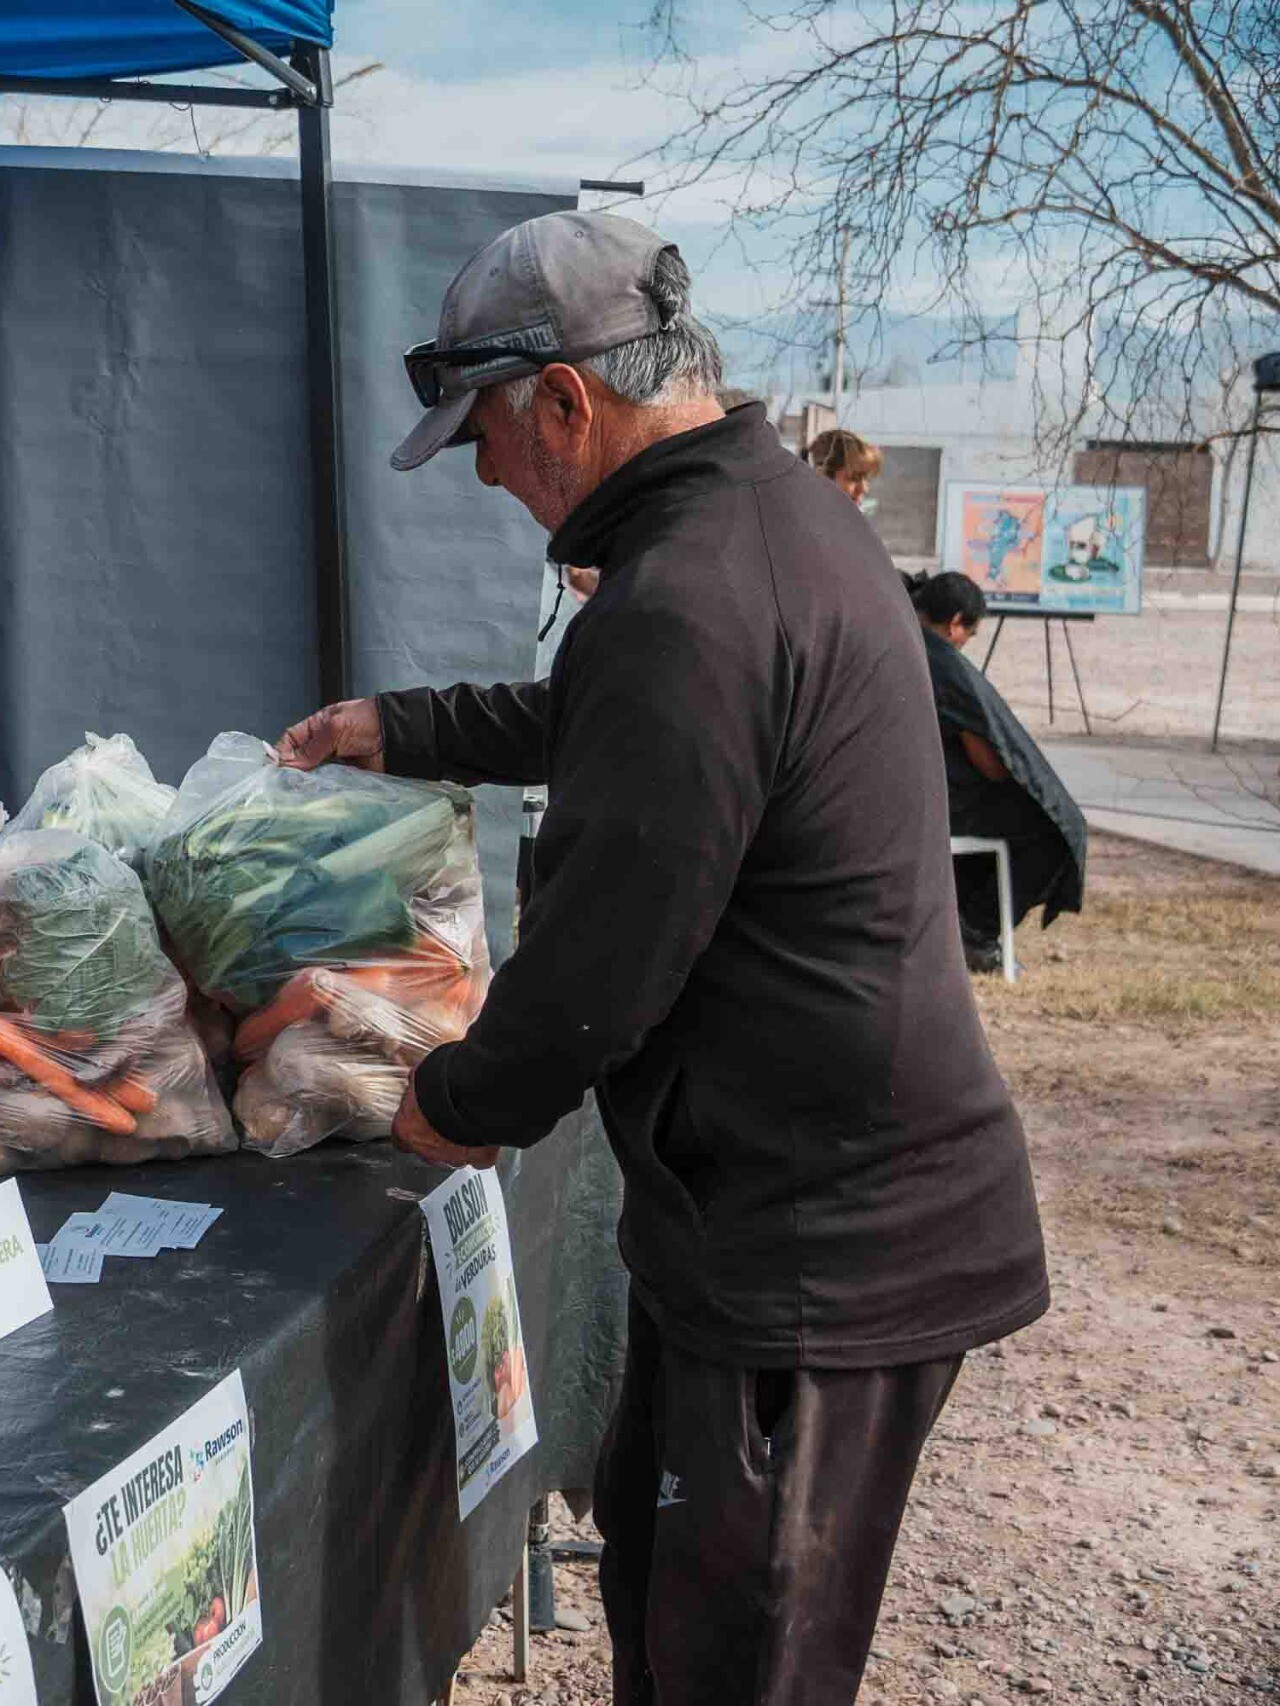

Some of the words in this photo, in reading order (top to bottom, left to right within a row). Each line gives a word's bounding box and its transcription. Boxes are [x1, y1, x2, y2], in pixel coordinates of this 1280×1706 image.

[443, 1174, 489, 1245] BOLSON
[461, 1244, 497, 1291] VERDURAS
[205, 1418, 243, 1462] Rawson
[95, 1501, 124, 1556] ¿TE
[121, 1445, 184, 1526] INTERESA
[131, 1488, 187, 1568] HUERTA?
